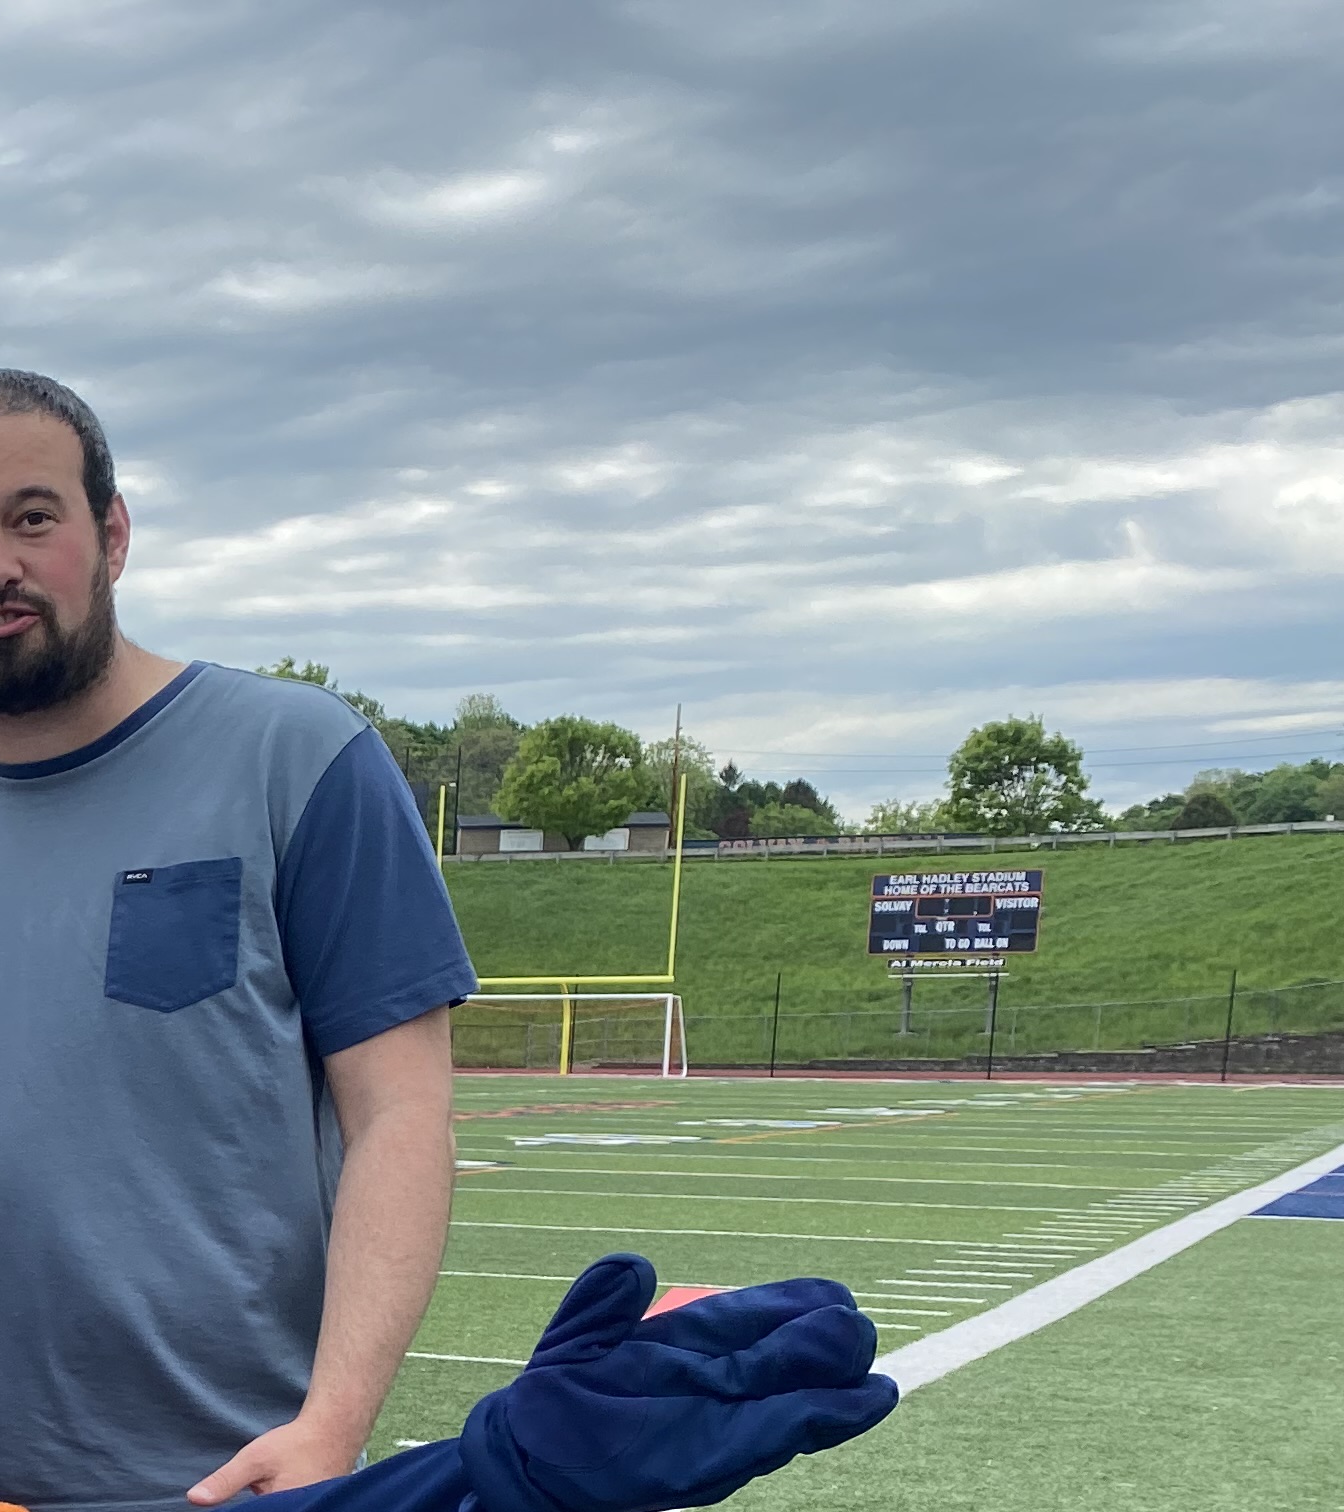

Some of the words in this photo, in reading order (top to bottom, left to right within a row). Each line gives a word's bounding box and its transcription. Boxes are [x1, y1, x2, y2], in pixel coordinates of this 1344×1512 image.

[889, 874, 919, 885] EARL
[922, 873, 969, 884] HADLEY
[972, 871, 1026, 883] STADIUM
[884, 885, 918, 896] HOME
[920, 885, 937, 894] OF
[941, 884, 963, 894] THE
[964, 882, 1029, 893] BEARCATS
[875, 901, 913, 912] SOLVAY
[995, 897, 1039, 909] VISITOR
[935, 921, 955, 933] QTR
[882, 939, 909, 951] DOWN
[944, 938, 956, 949] TO
[958, 938, 970, 949] GO
[974, 938, 995, 949] BALL
[996, 937, 1009, 949] ON
[966, 958, 1004, 967] Field
